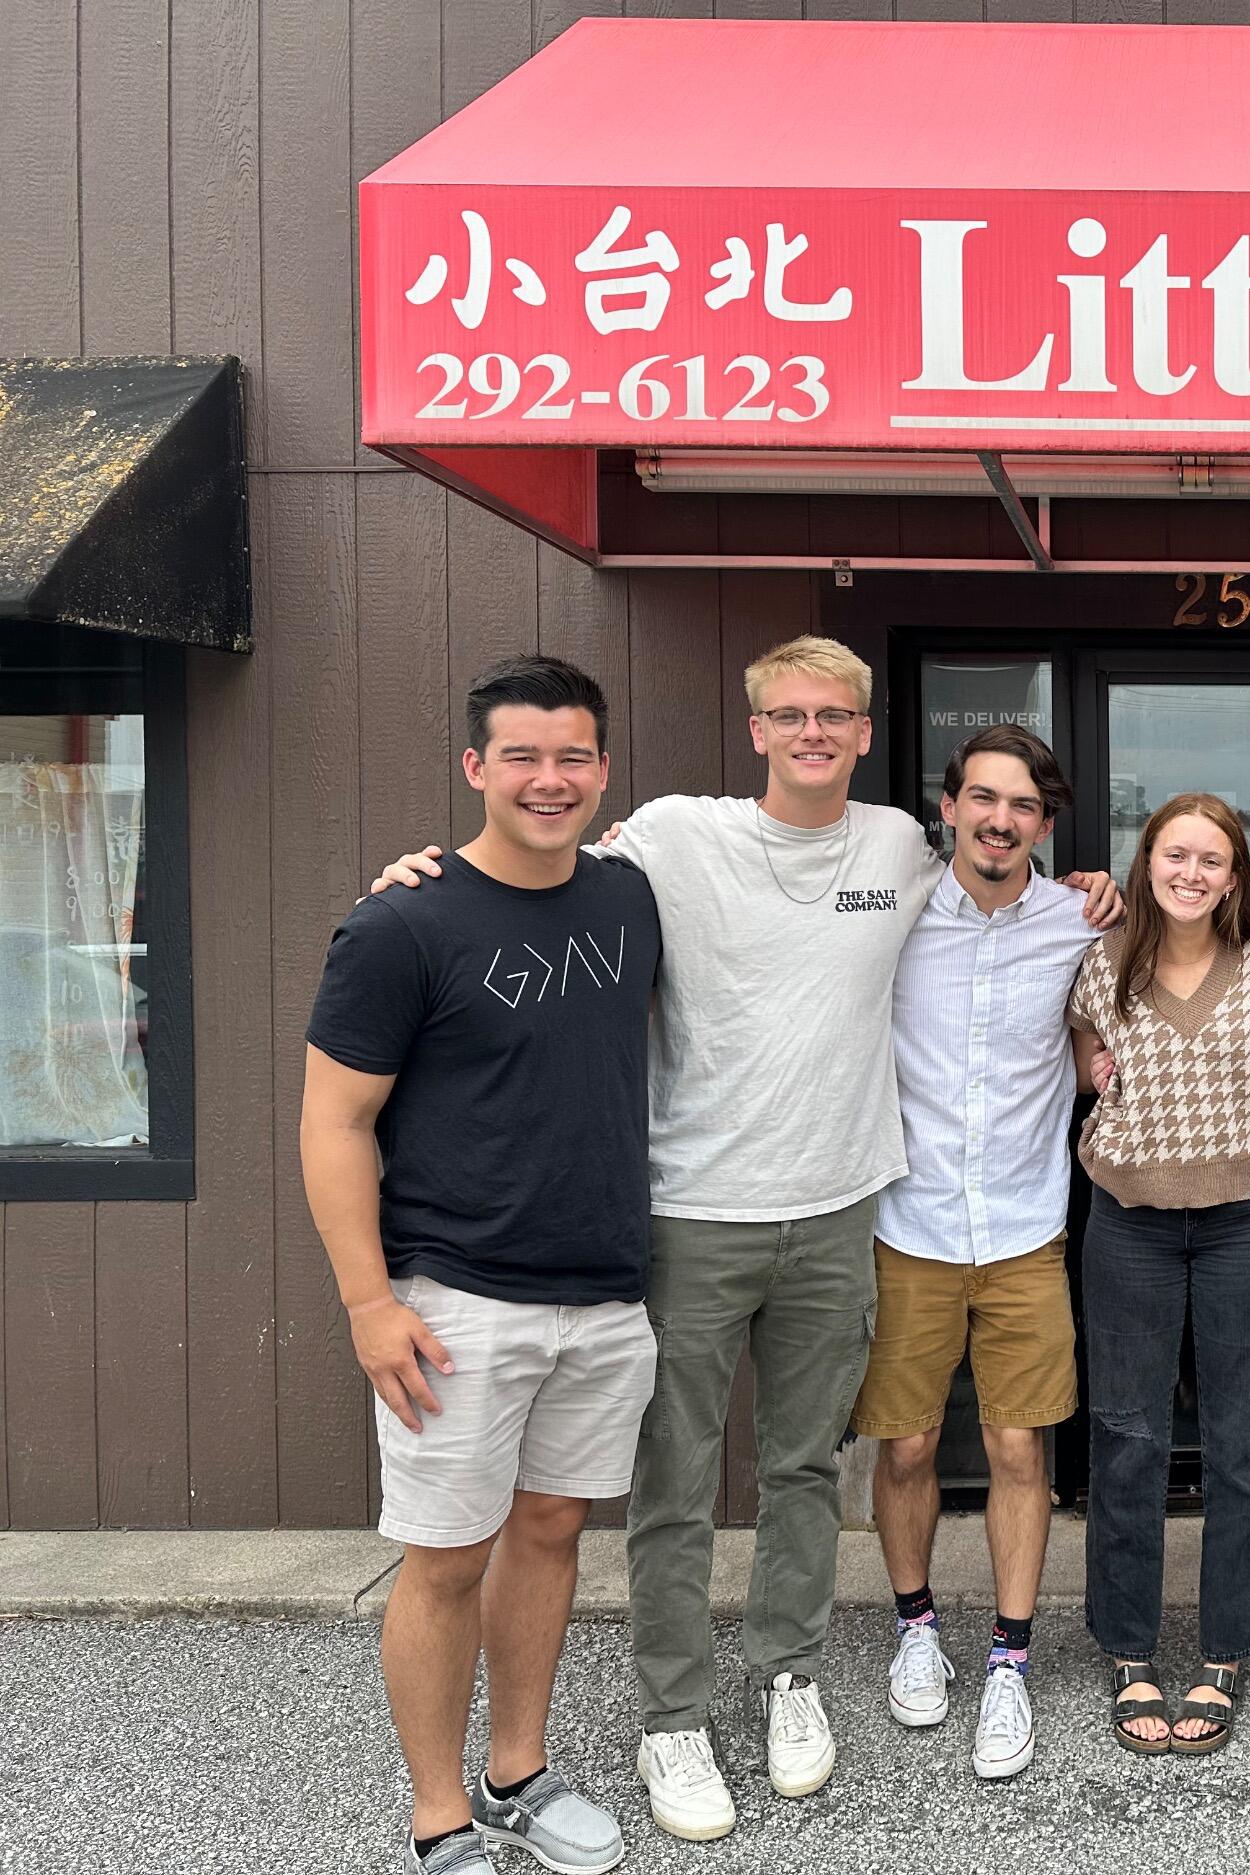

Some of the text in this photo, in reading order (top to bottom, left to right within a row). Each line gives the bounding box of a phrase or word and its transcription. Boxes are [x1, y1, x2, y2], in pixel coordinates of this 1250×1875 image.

[405, 205, 853, 335] 小台北
[414, 353, 831, 423] 292-6123
[929, 711, 1046, 728] WE DELIVER!
[837, 889, 897, 902] THE SALT
[835, 900, 898, 912] COMPANY
